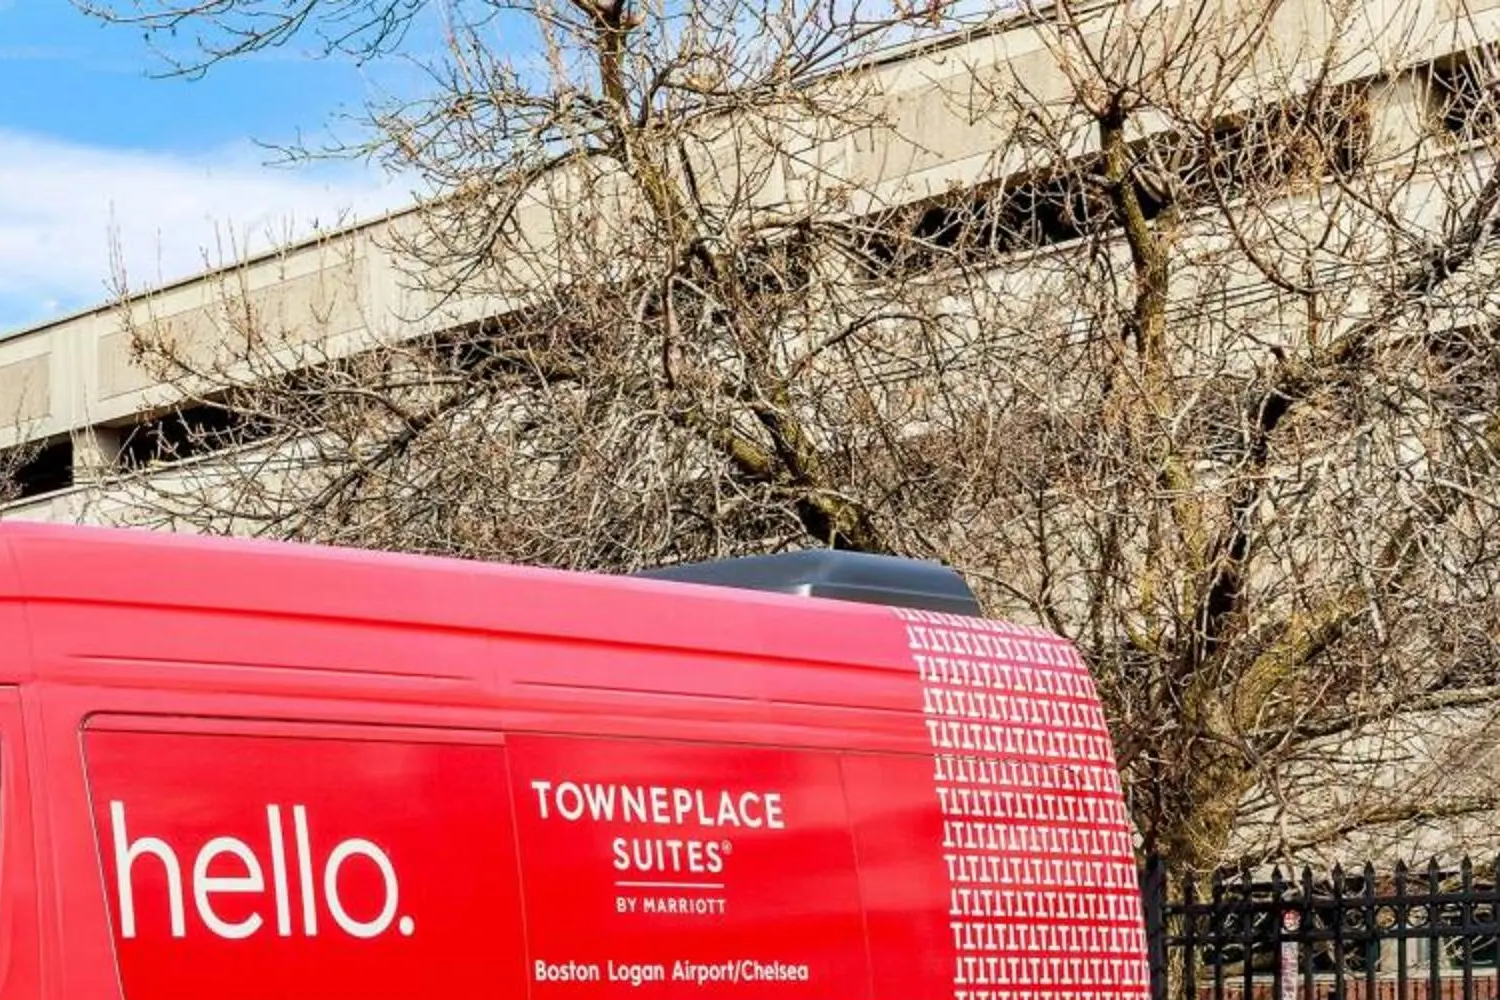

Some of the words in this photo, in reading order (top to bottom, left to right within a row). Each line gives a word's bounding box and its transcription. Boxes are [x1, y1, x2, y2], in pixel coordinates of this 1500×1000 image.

[531, 781, 785, 829] TOWNEPLACE
[110, 800, 414, 939] hello.
[616, 897, 636, 912] BY
[644, 898, 725, 914] MARRIOTT
[535, 960, 600, 981] Boston
[608, 960, 664, 986] Logan
[672, 960, 808, 985] Airport/Chelsea
